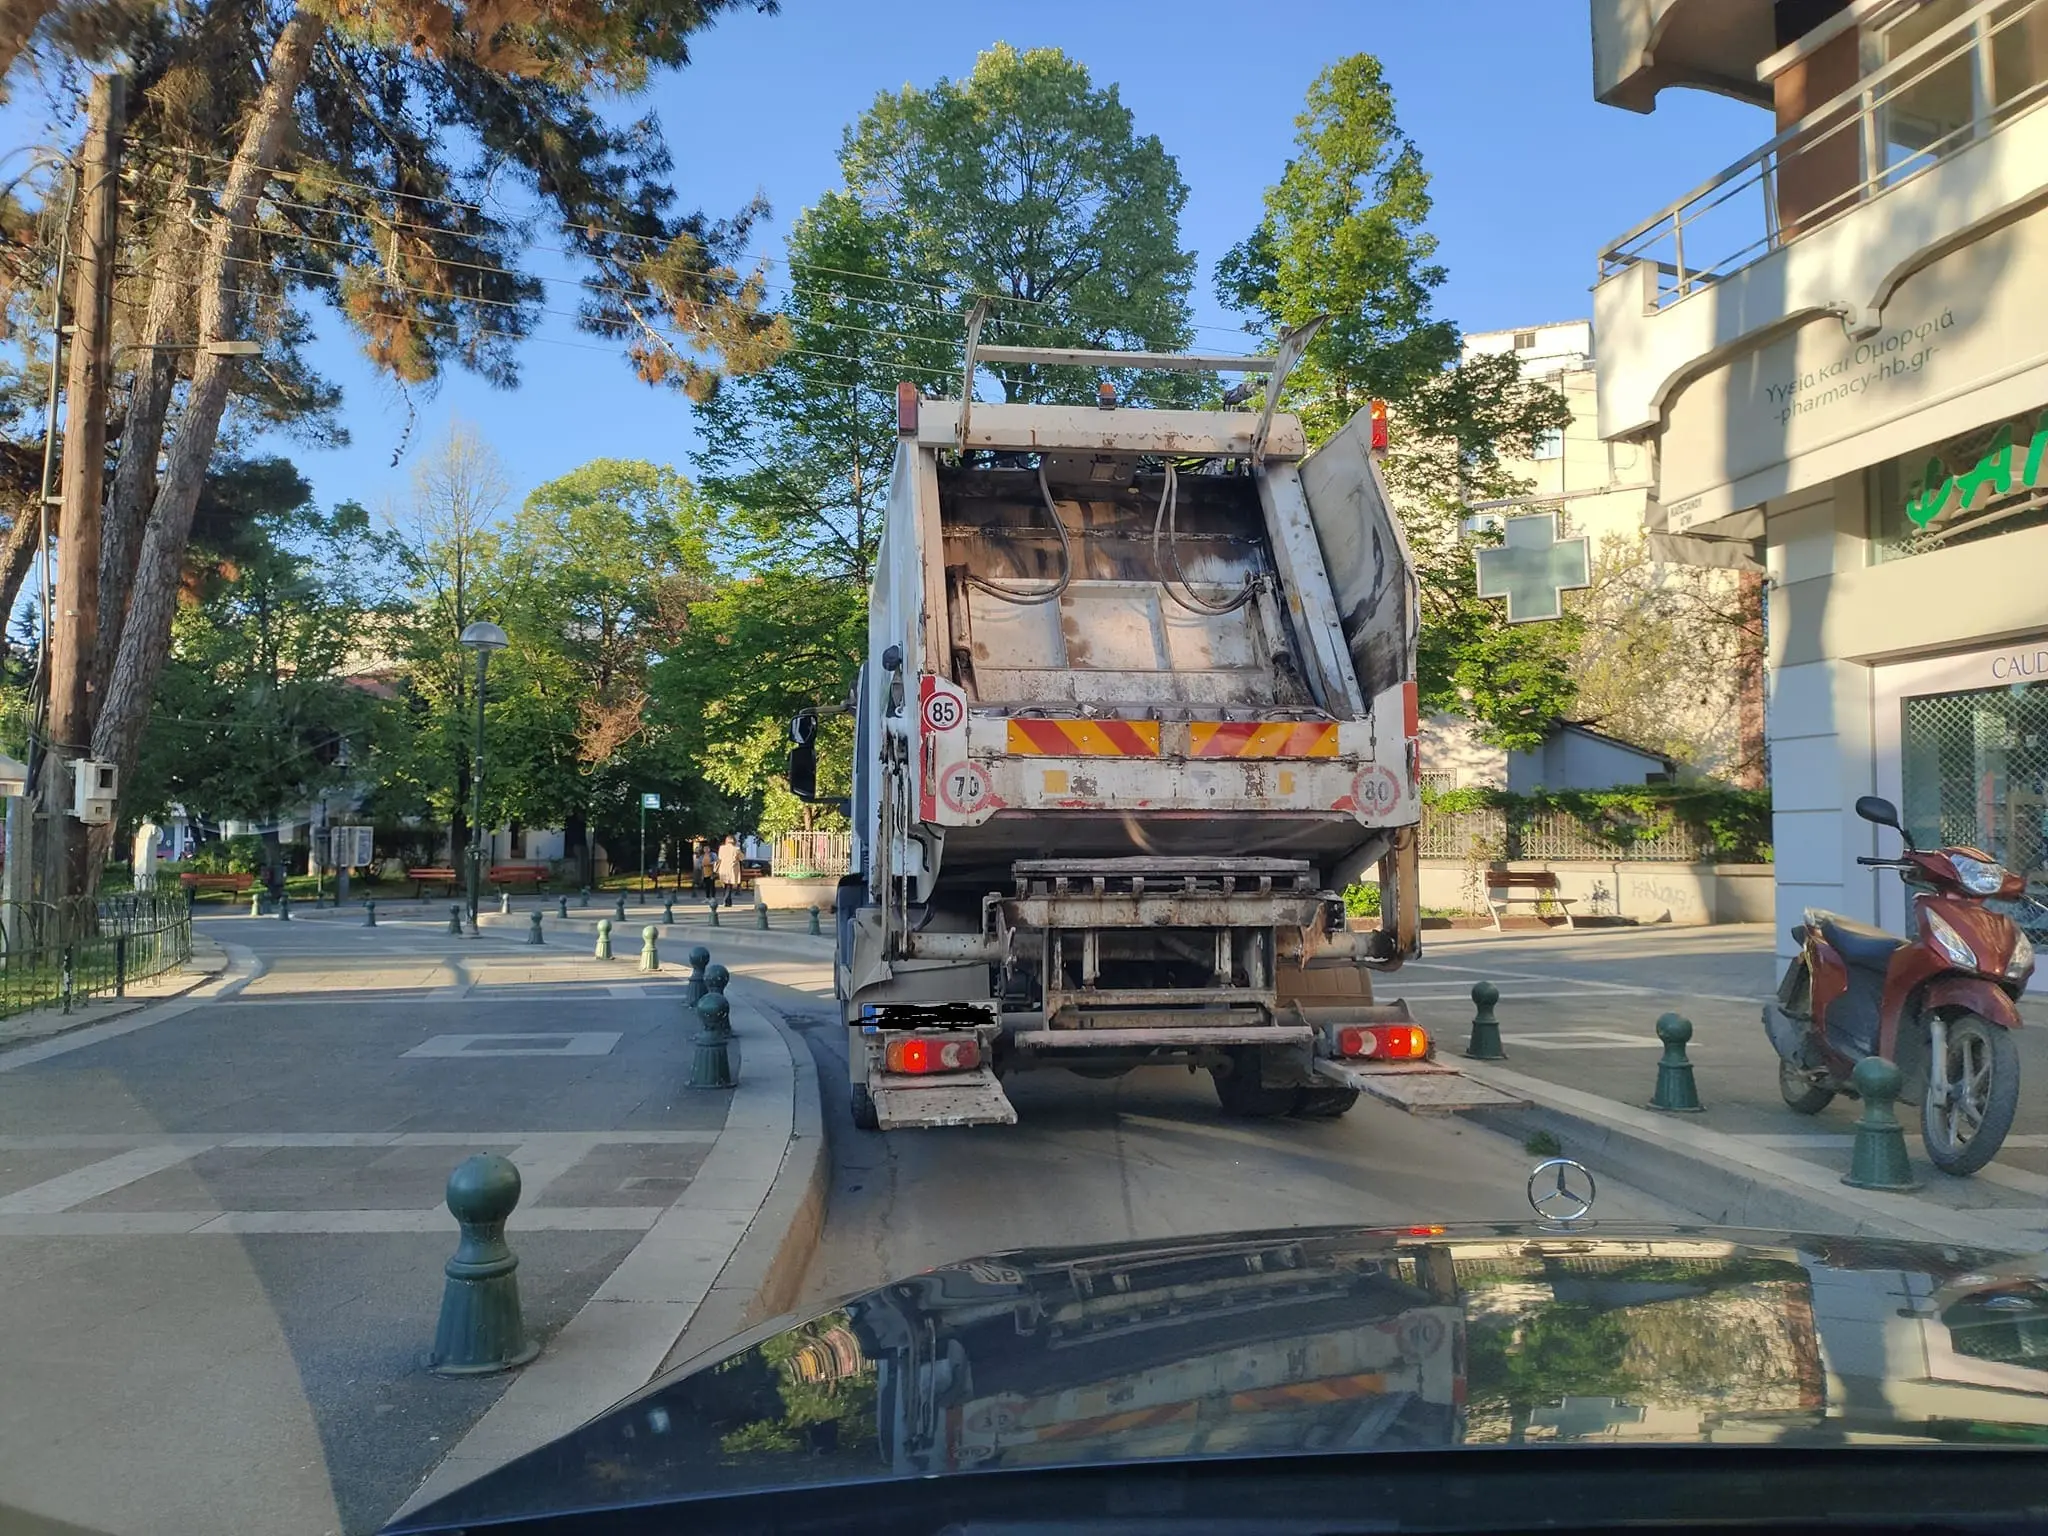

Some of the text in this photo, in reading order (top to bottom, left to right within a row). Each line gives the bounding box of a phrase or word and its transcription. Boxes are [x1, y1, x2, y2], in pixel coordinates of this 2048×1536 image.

[1819, 357, 1849, 384] και
[1855, 307, 1955, 365] Ομορφιά
[932, 702, 954, 722] 85
[1365, 780, 1389, 801] 80
